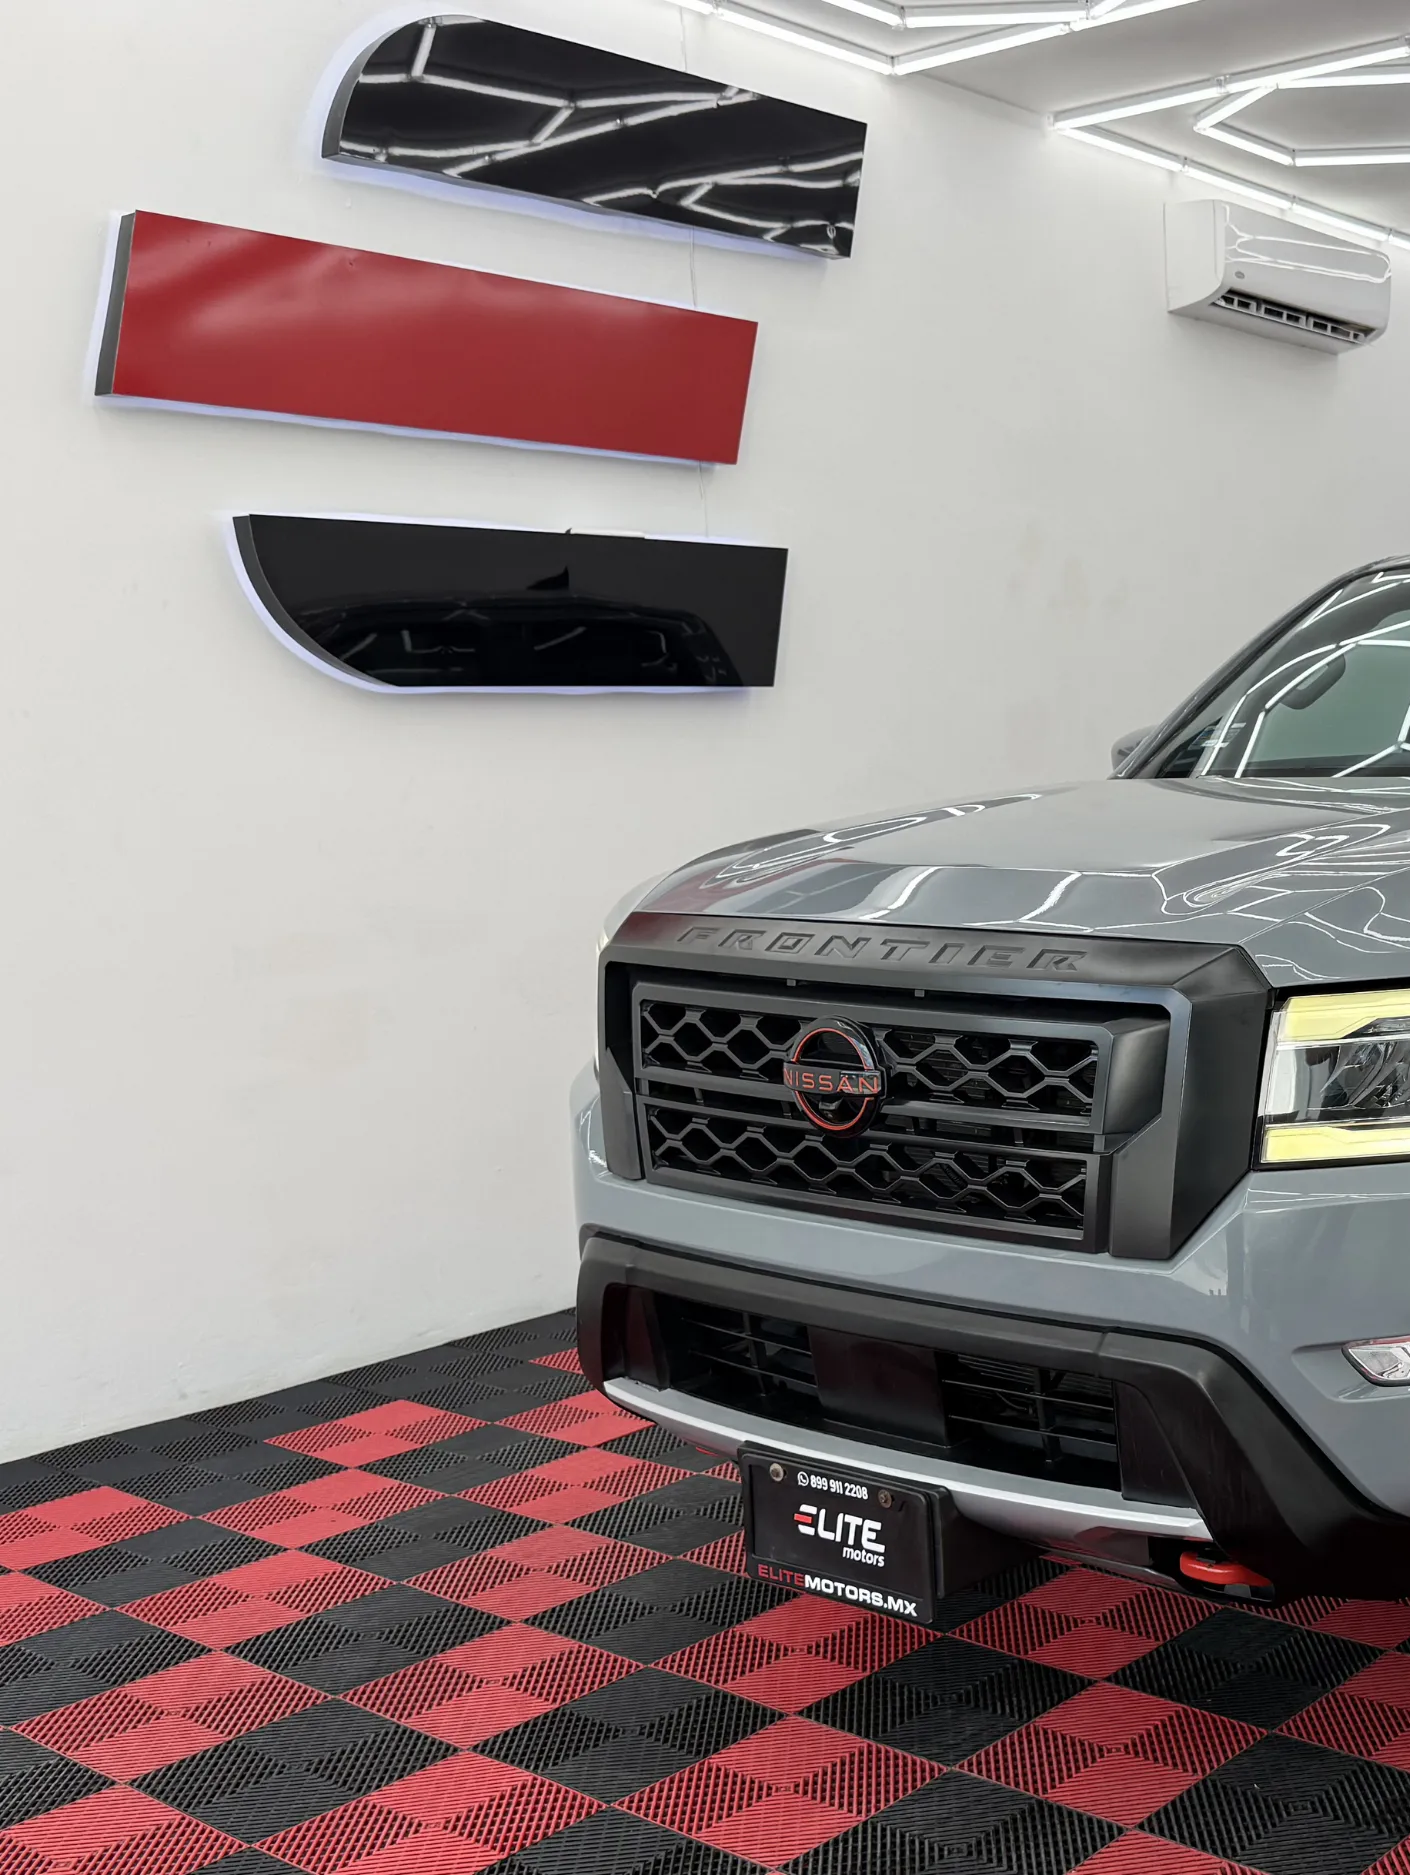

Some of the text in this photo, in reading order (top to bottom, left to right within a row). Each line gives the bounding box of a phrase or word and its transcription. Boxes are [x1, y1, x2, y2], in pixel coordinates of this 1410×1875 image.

[677, 926, 1088, 972] FRONTIER
[783, 1067, 879, 1094] NISSAN
[810, 1474, 869, 1500] 899 911 2208
[794, 1504, 886, 1553] ELITE
[842, 1546, 885, 1567] motors
[757, 1563, 918, 1617] ELITEMOTORS.MX
